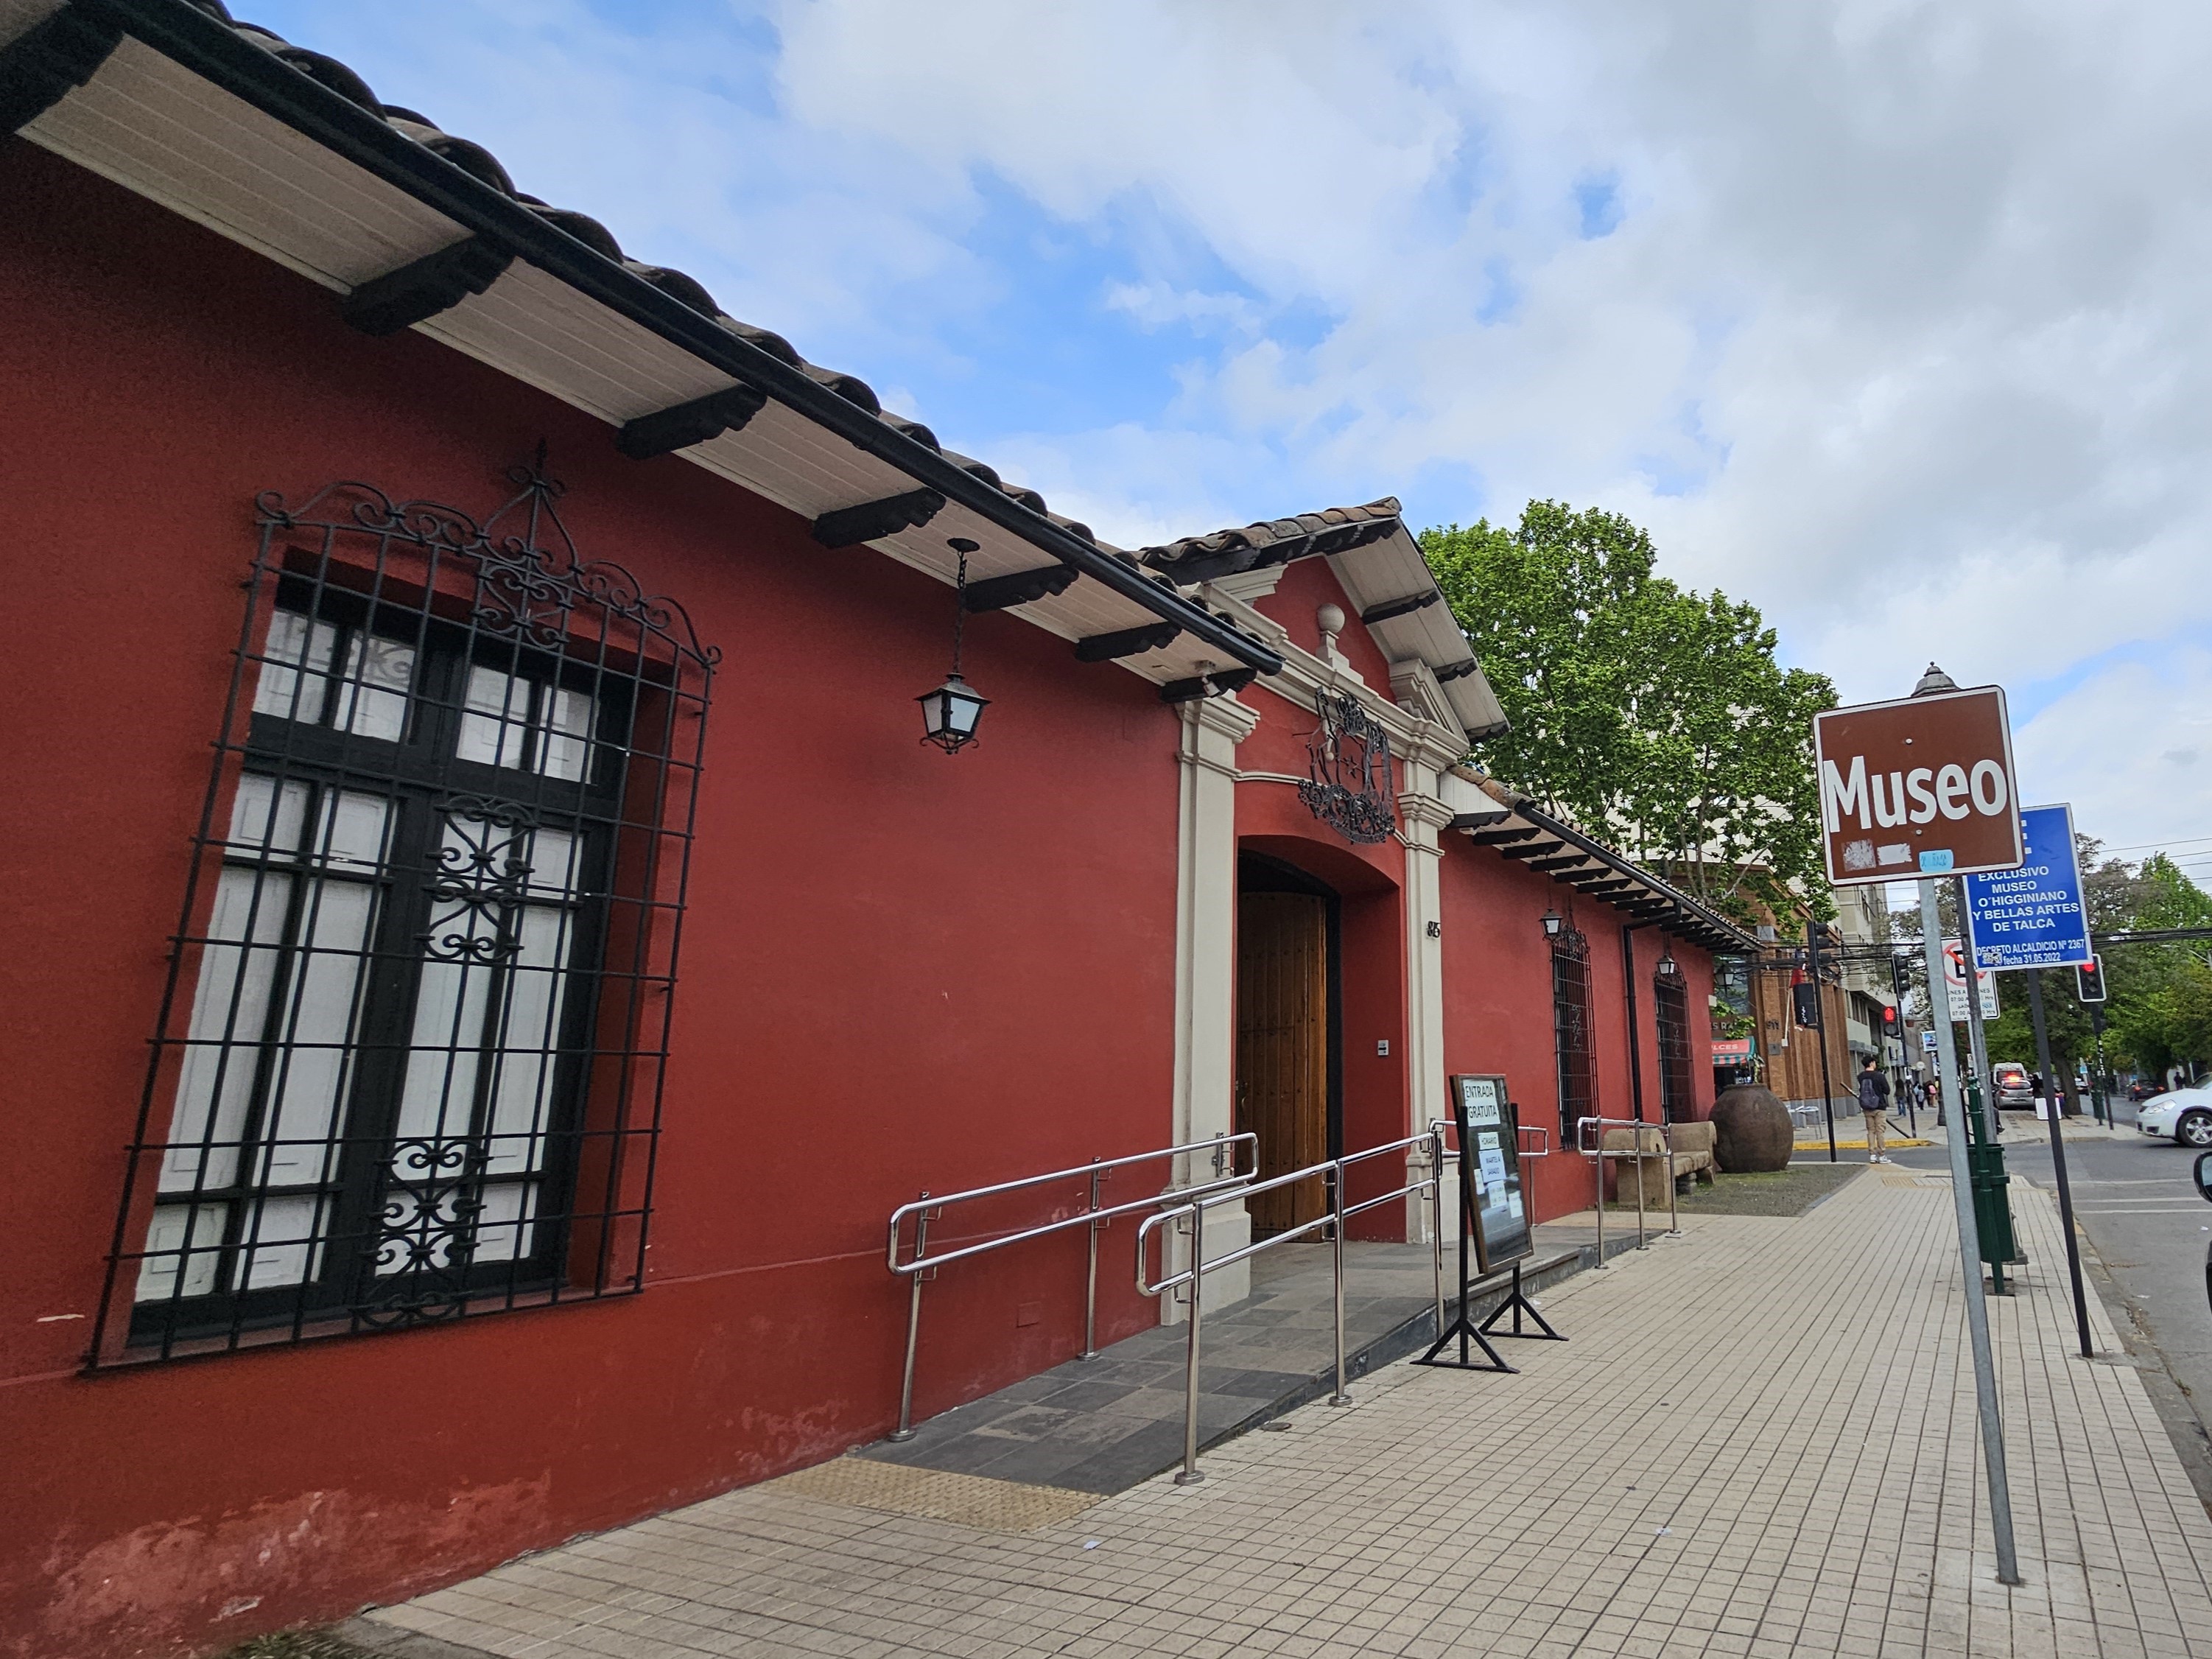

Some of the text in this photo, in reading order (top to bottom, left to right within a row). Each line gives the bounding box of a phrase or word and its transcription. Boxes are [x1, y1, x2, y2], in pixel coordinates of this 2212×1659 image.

[1822, 755, 2007, 833] Museo
[1978, 866, 2049, 882] EXCLUSIVO
[1991, 880, 2037, 894] MUSEO
[1973, 902, 2080, 921] Y BELLAS ARTES
[1992, 918, 2056, 933] DE TALCA
[2012, 941, 2057, 953] ALCALDICIO
[2003, 955, 2023, 965] fecha
[1465, 1085, 1494, 1098] ENTRADA
[1468, 1105, 1498, 1118] GRATUITA
